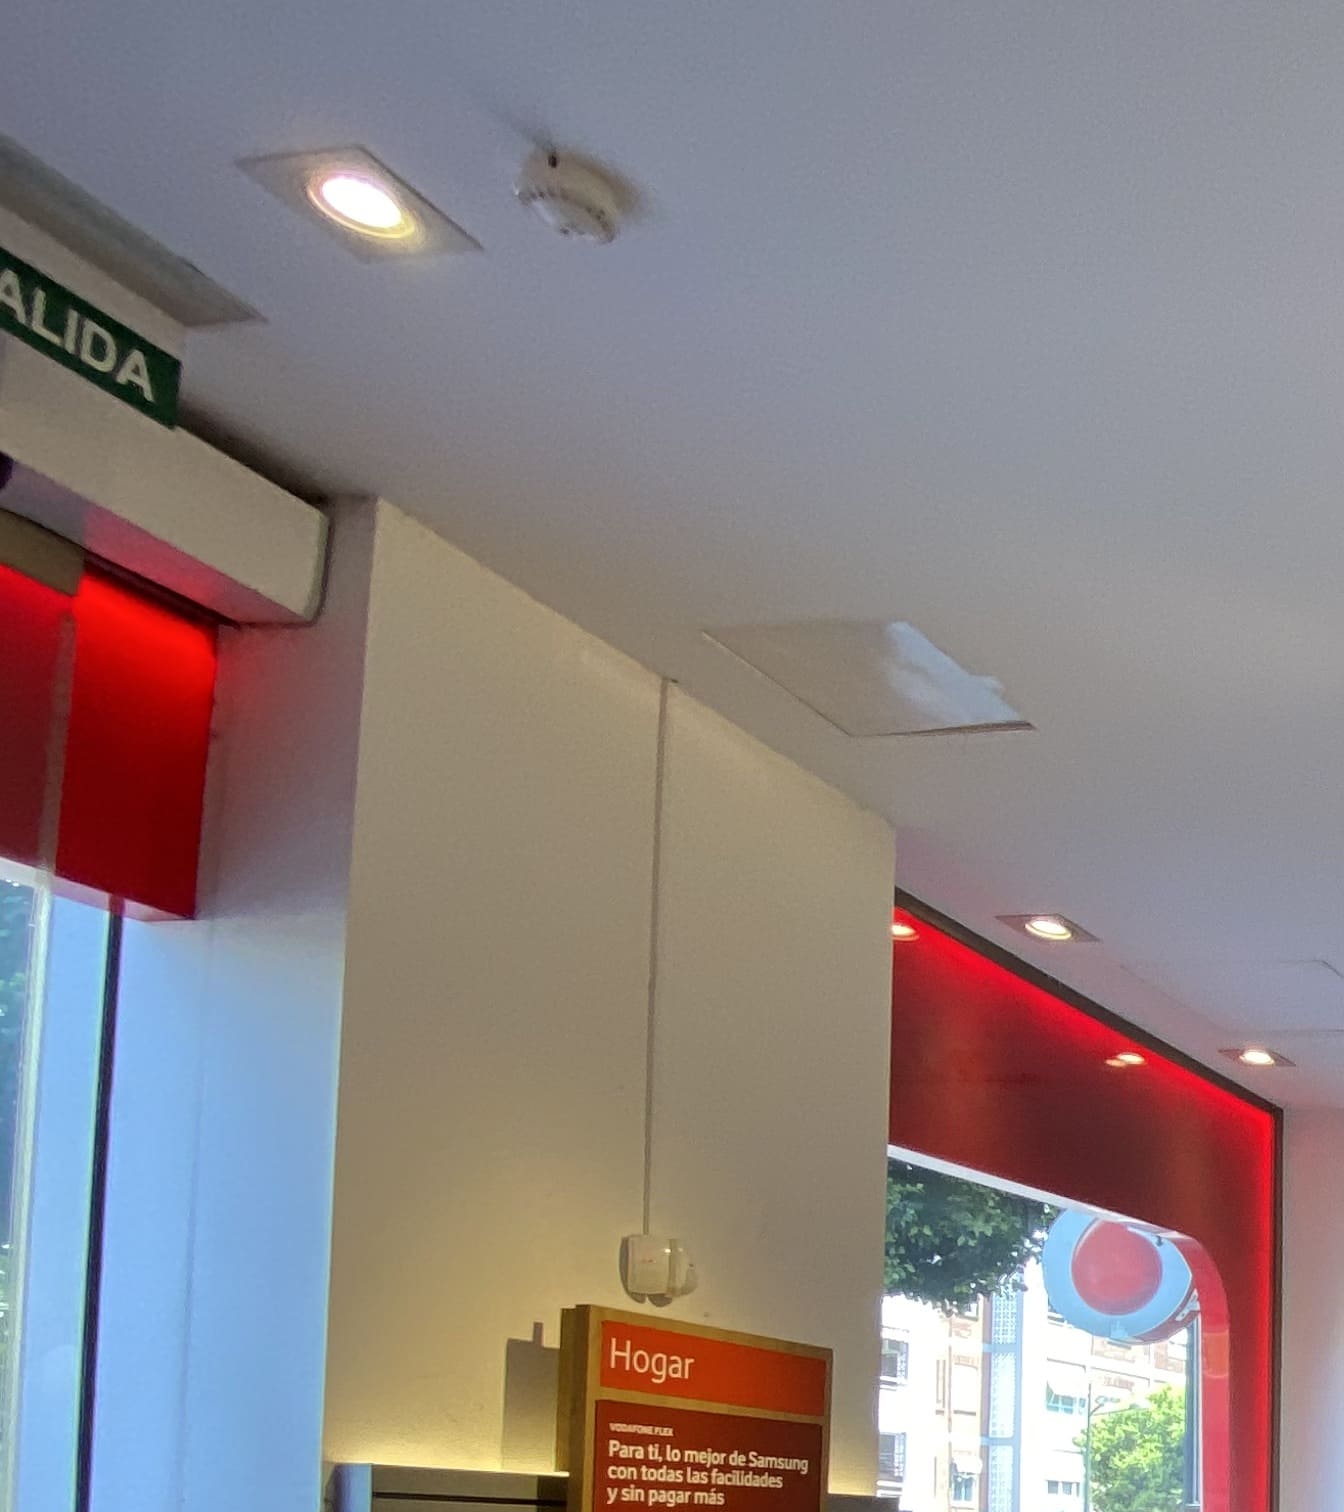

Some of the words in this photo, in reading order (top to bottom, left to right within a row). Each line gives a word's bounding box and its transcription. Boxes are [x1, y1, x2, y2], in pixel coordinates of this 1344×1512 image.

[610, 1337, 695, 1384] Hogar
[608, 1440, 644, 1459] Para
[648, 1444, 663, 1463] ti,
[666, 1445, 681, 1462] lo
[684, 1448, 727, 1467] mejor
[729, 1451, 746, 1465] de
[748, 1452, 809, 1474] Samsung
[607, 1466, 637, 1481] con
[641, 1465, 683, 1482] todas
[687, 1467, 708, 1484] las
[711, 1468, 783, 1488] facilidades
[606, 1487, 618, 1504] y
[621, 1485, 645, 1501] sin
[648, 1489, 691, 1507] pagar
[694, 1488, 725, 1505] más
